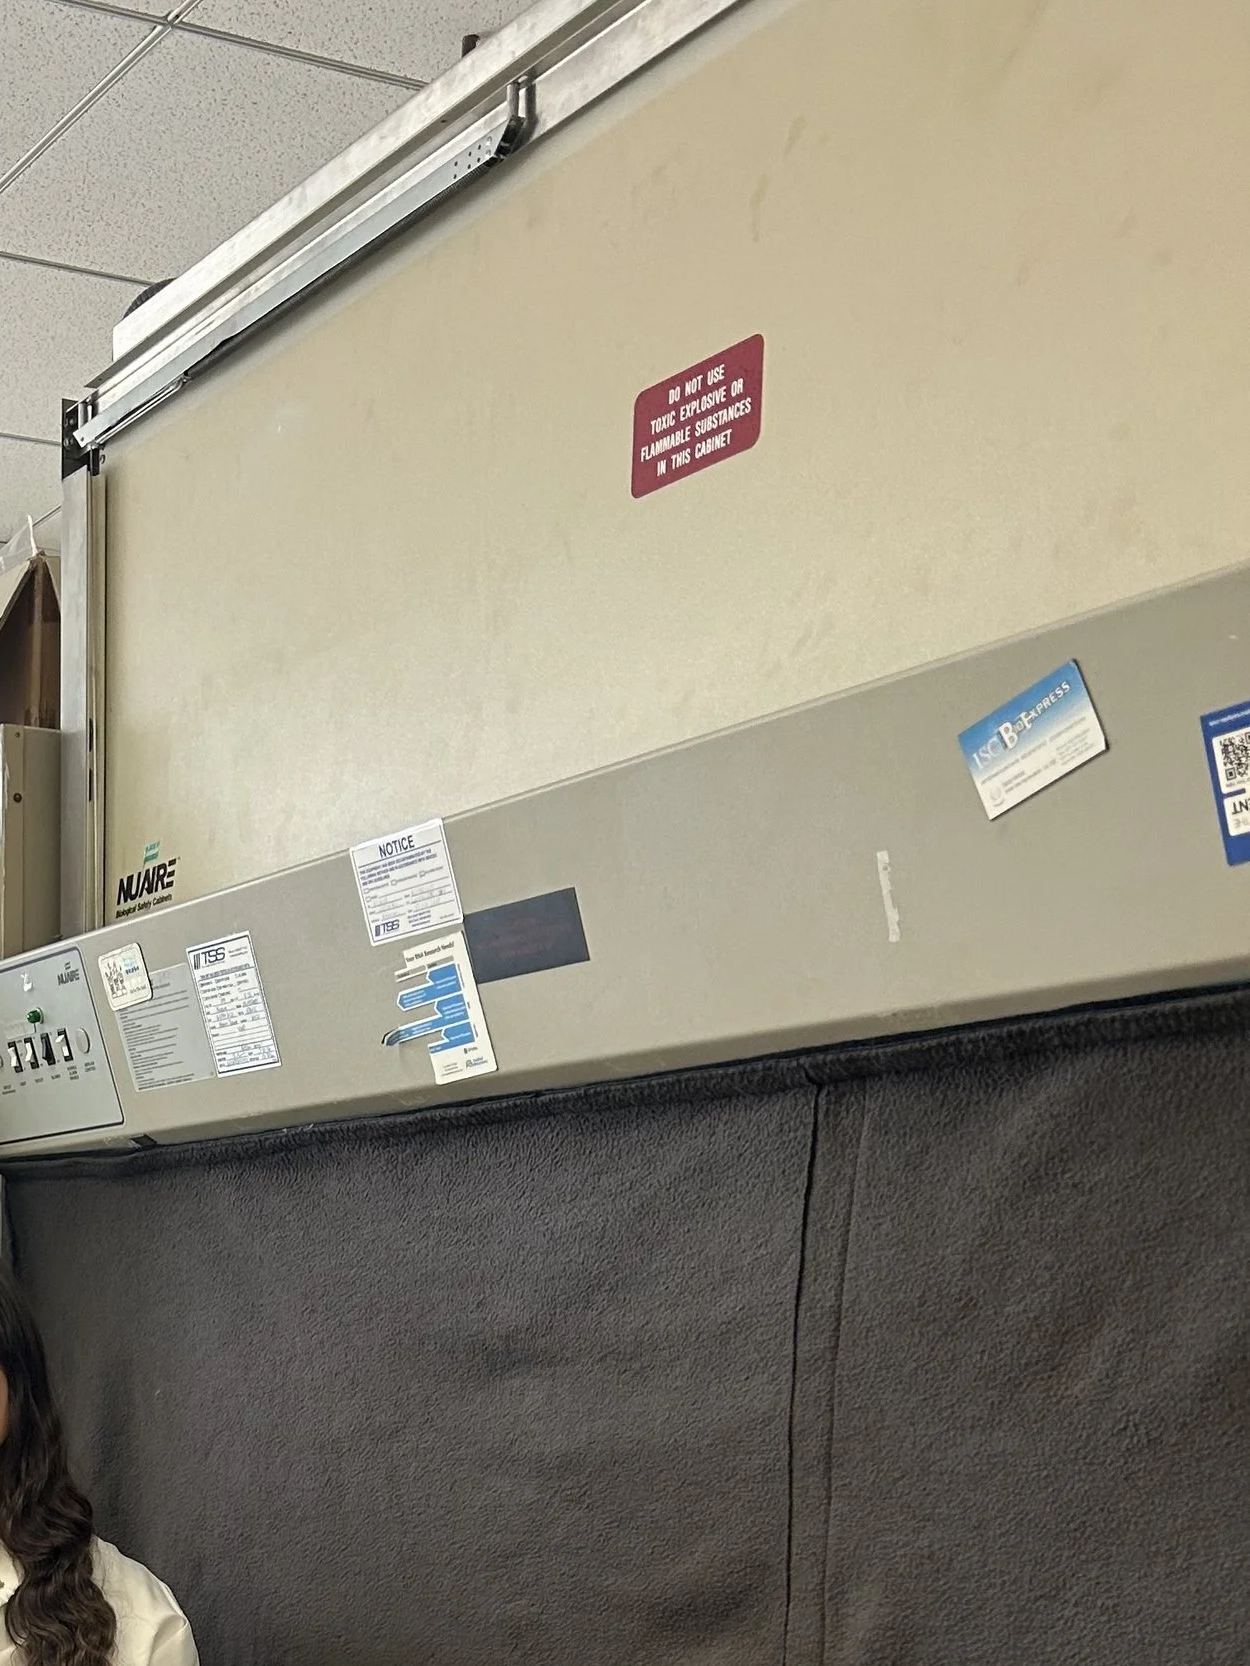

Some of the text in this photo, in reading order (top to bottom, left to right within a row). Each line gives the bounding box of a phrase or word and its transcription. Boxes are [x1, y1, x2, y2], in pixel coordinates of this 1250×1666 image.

[650, 377, 744, 436] TOXIC EXPLOSIVE OR
[668, 364, 725, 405] DO NOT USE
[640, 397, 752, 462] FLAMMABLE SUBSTANCES
[656, 428, 732, 476] IN THIS CABINET
[378, 834, 416, 859] NOTICE
[116, 857, 178, 906] NUAIRE
[200, 946, 226, 965] TSS
